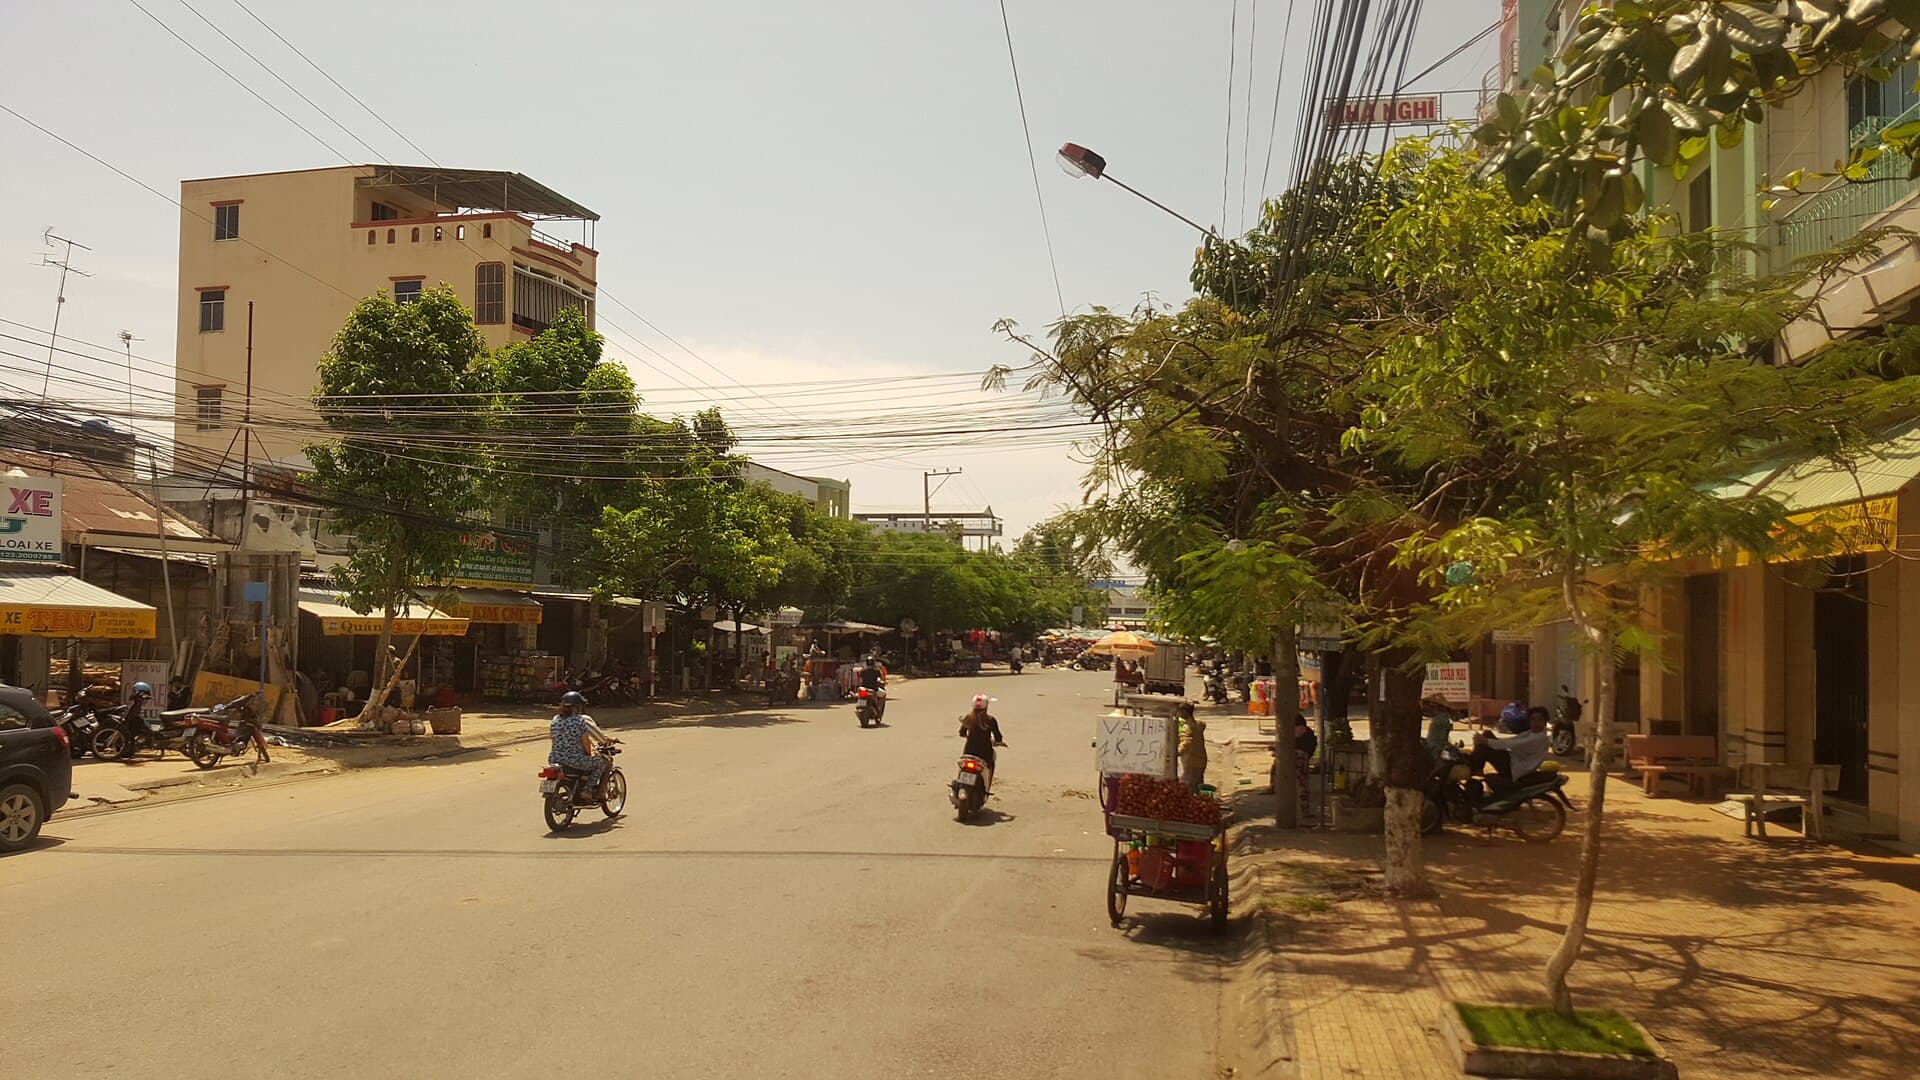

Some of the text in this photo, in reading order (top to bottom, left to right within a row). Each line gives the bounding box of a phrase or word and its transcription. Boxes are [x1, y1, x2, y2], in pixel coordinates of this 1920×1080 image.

[8, 487, 53, 517] XE
[35, 541, 53, 550] XE
[5, 612, 21, 624] XE
